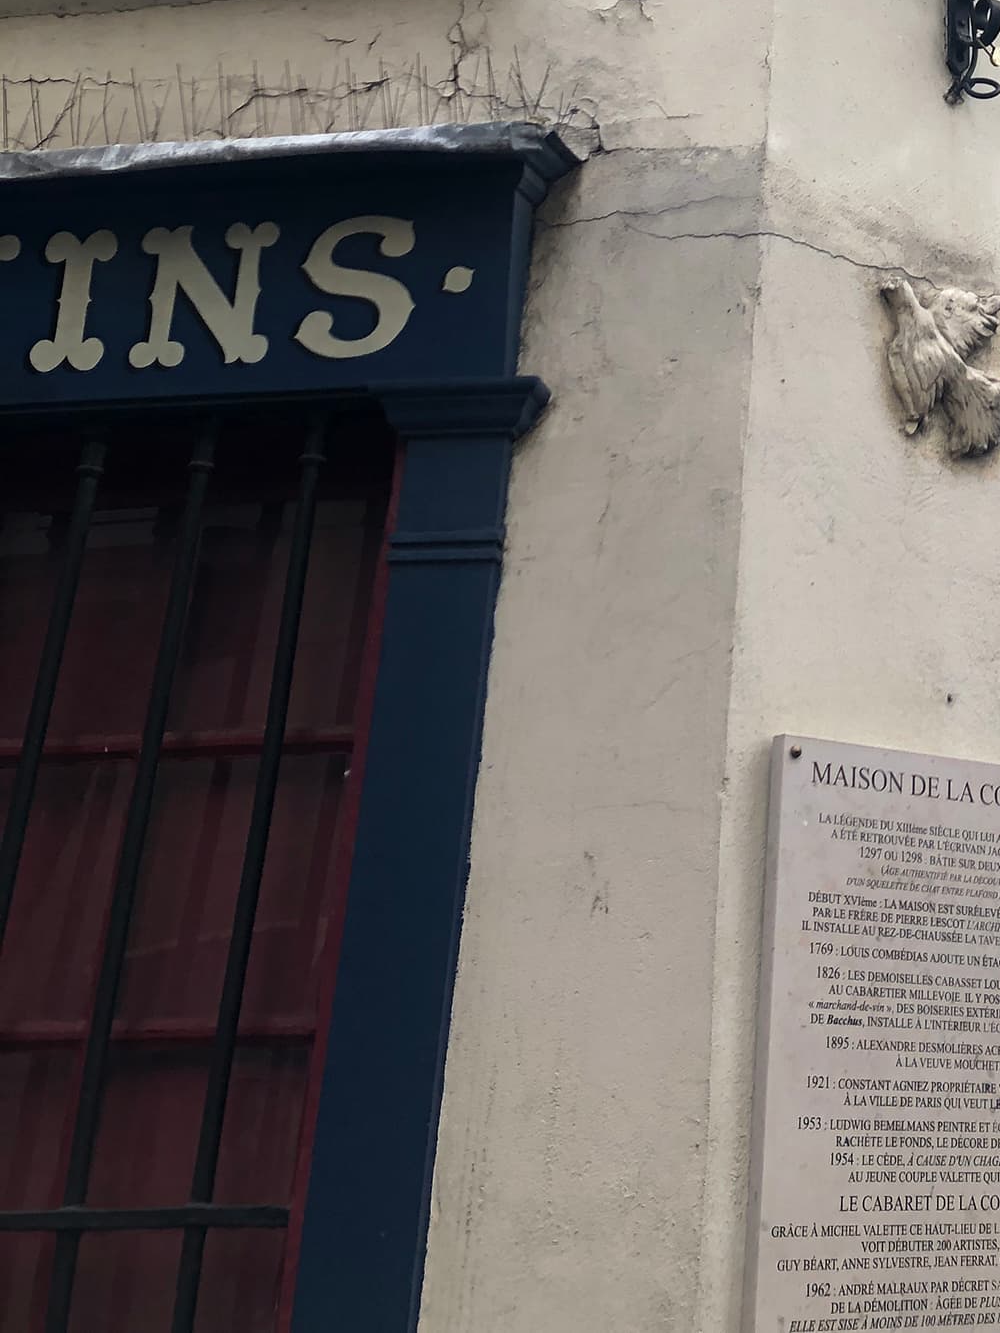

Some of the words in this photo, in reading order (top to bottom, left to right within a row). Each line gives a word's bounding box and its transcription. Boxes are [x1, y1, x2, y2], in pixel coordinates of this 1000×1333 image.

[0, 215, 416, 373] INS
[811, 762, 904, 795] MAISON
[910, 774, 940, 800] DE
[946, 778, 974, 804] LA
[848, 1172, 863, 1183] AU
[864, 1172, 897, 1183] JEUNE
[899, 1172, 938, 1183] COUPLE
[939, 1172, 981, 1183] VALETTE
[982, 1172, 1000, 1185] QUI
[840, 1196, 858, 1212] LE
[861, 1195, 931, 1212] CABARET
[935, 1195, 955, 1211] DE
[959, 1195, 978, 1211] LA
[771, 1223, 807, 1238] GRÂCE
[820, 1225, 861, 1237] MICHEL
[863, 1224, 907, 1237] VALETTE
[909, 1224, 922, 1236] CE
[924, 1224, 976, 1236] HAUT-LIEU
[978, 1223, 992, 1235] DE
[861, 1241, 886, 1253] VOIT
[887, 1238, 934, 1252] DÉBUTER
[936, 1240, 951, 1252] 200
[953, 1239, 1000, 1253] ARTISTES,
